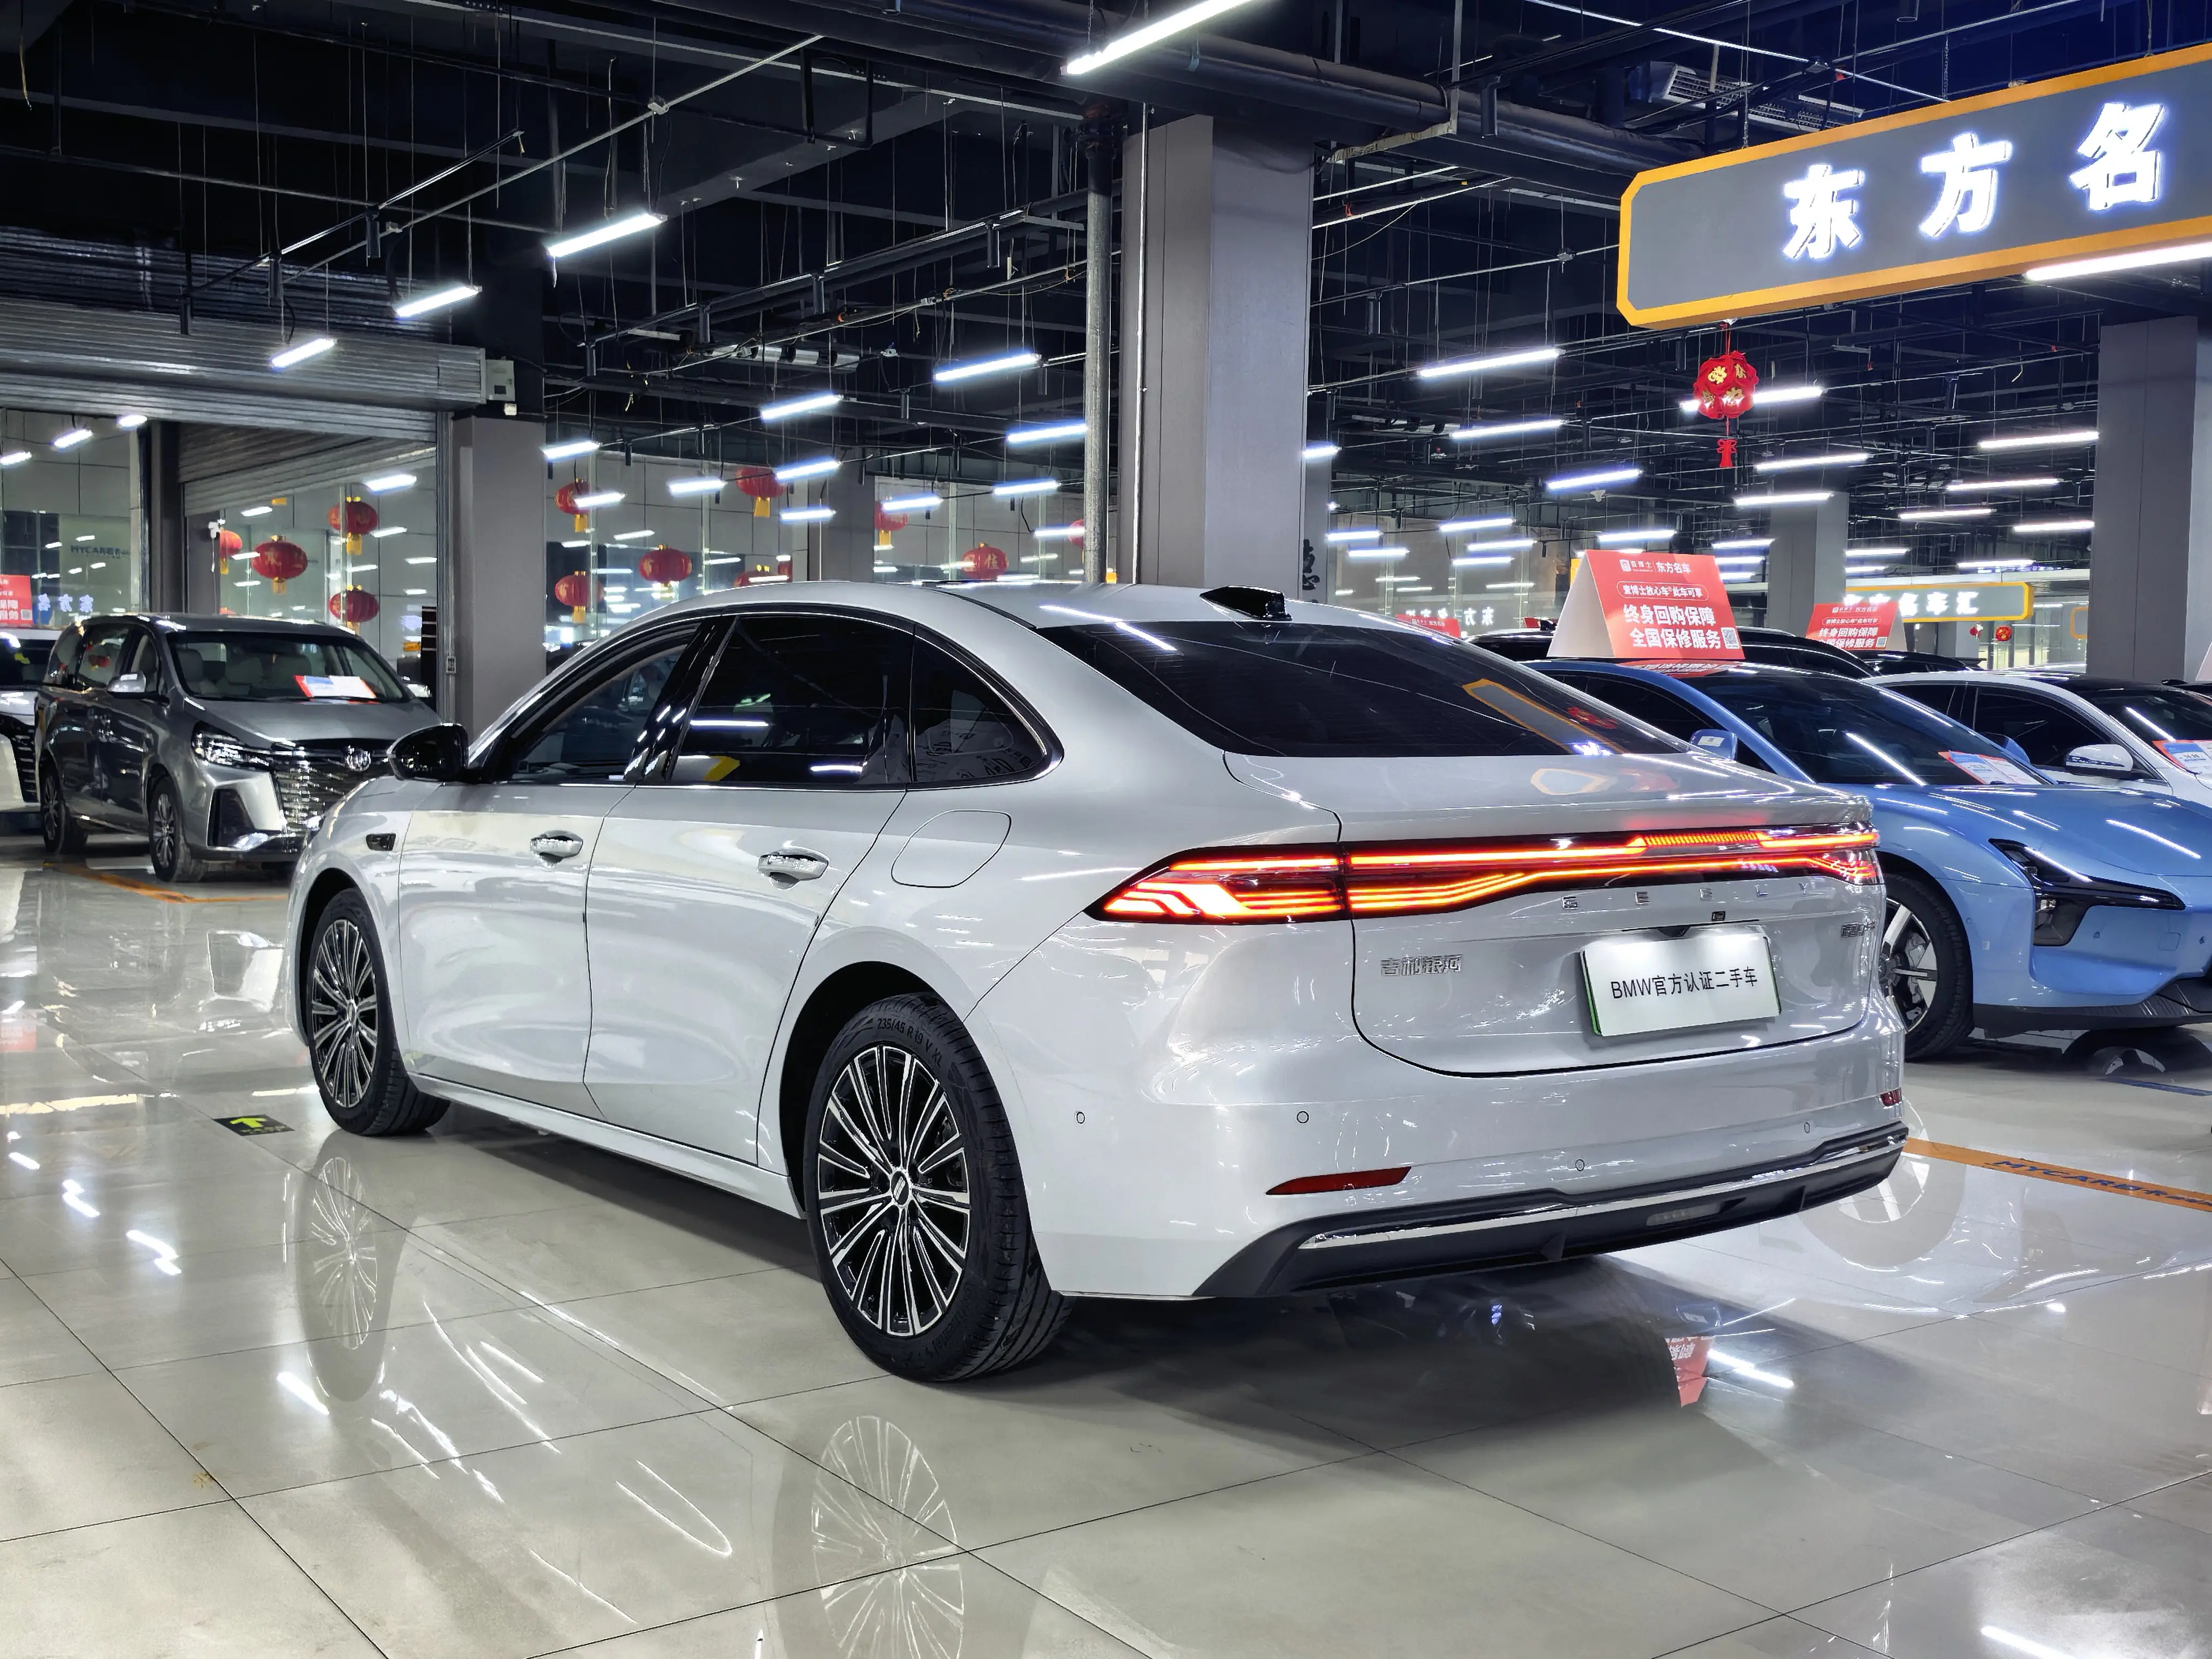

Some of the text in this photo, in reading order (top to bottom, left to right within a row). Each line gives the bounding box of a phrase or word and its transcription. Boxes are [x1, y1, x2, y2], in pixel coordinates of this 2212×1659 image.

[1782, 102, 2166, 260] 东方名
[1656, 562, 1692, 574] 东方名车
[1623, 603, 1716, 626] 终身回购保障
[1629, 626, 1722, 649] 全国保修服务
[1818, 626, 1879, 637] 终身回购保障
[1562, 881, 1810, 911] GEELY
[1380, 954, 1463, 976] 吉利银河
[1610, 966, 1757, 999] BMW官方认证二手车
